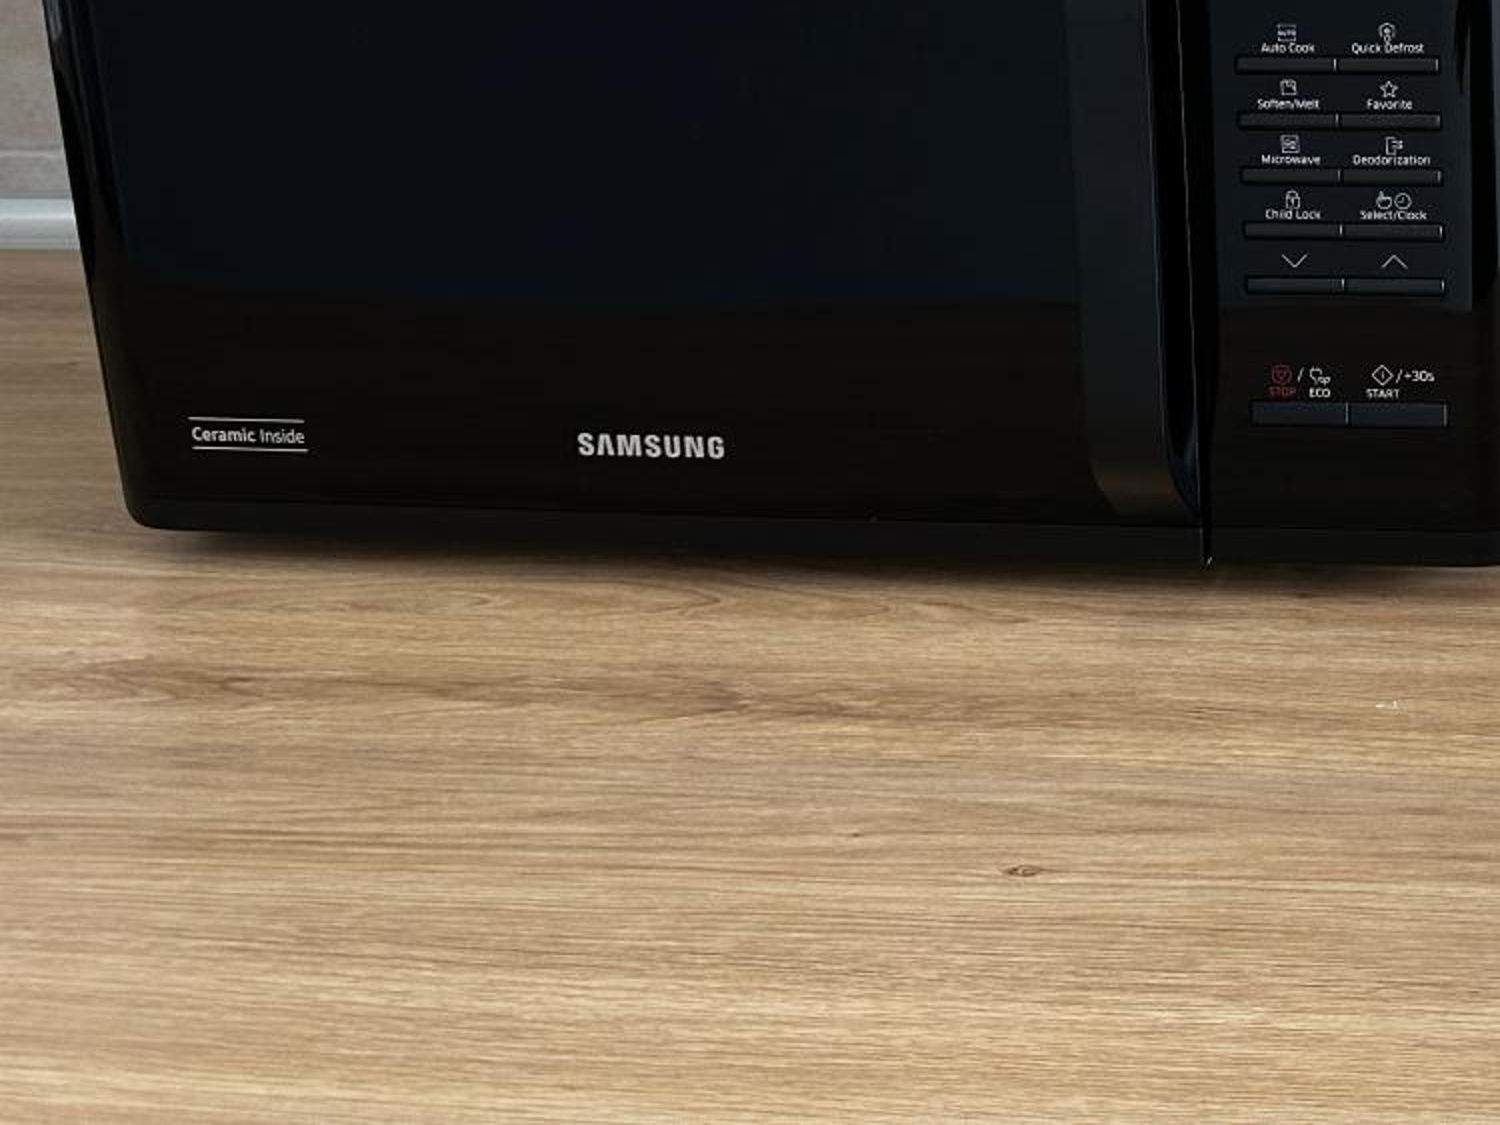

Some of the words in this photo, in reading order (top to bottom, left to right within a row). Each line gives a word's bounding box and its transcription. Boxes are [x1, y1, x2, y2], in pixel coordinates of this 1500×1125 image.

[1261, 43, 1287, 53] Auto
[1289, 42, 1315, 53] Cook
[1351, 43, 1381, 54] Quick
[1385, 42, 1424, 54] Defrost
[1366, 98, 1413, 109] Favorite
[1261, 154, 1321, 165] Microwave
[1352, 154, 1431, 165] Deodorization
[1265, 209, 1293, 220] Child
[1296, 209, 1321, 220] Lock
[1308, 387, 1331, 398] ECO
[1366, 388, 1400, 398] START
[191, 426, 257, 442] Ceramic
[259, 428, 305, 444] Inside
[577, 432, 725, 460] SAMSUNG
